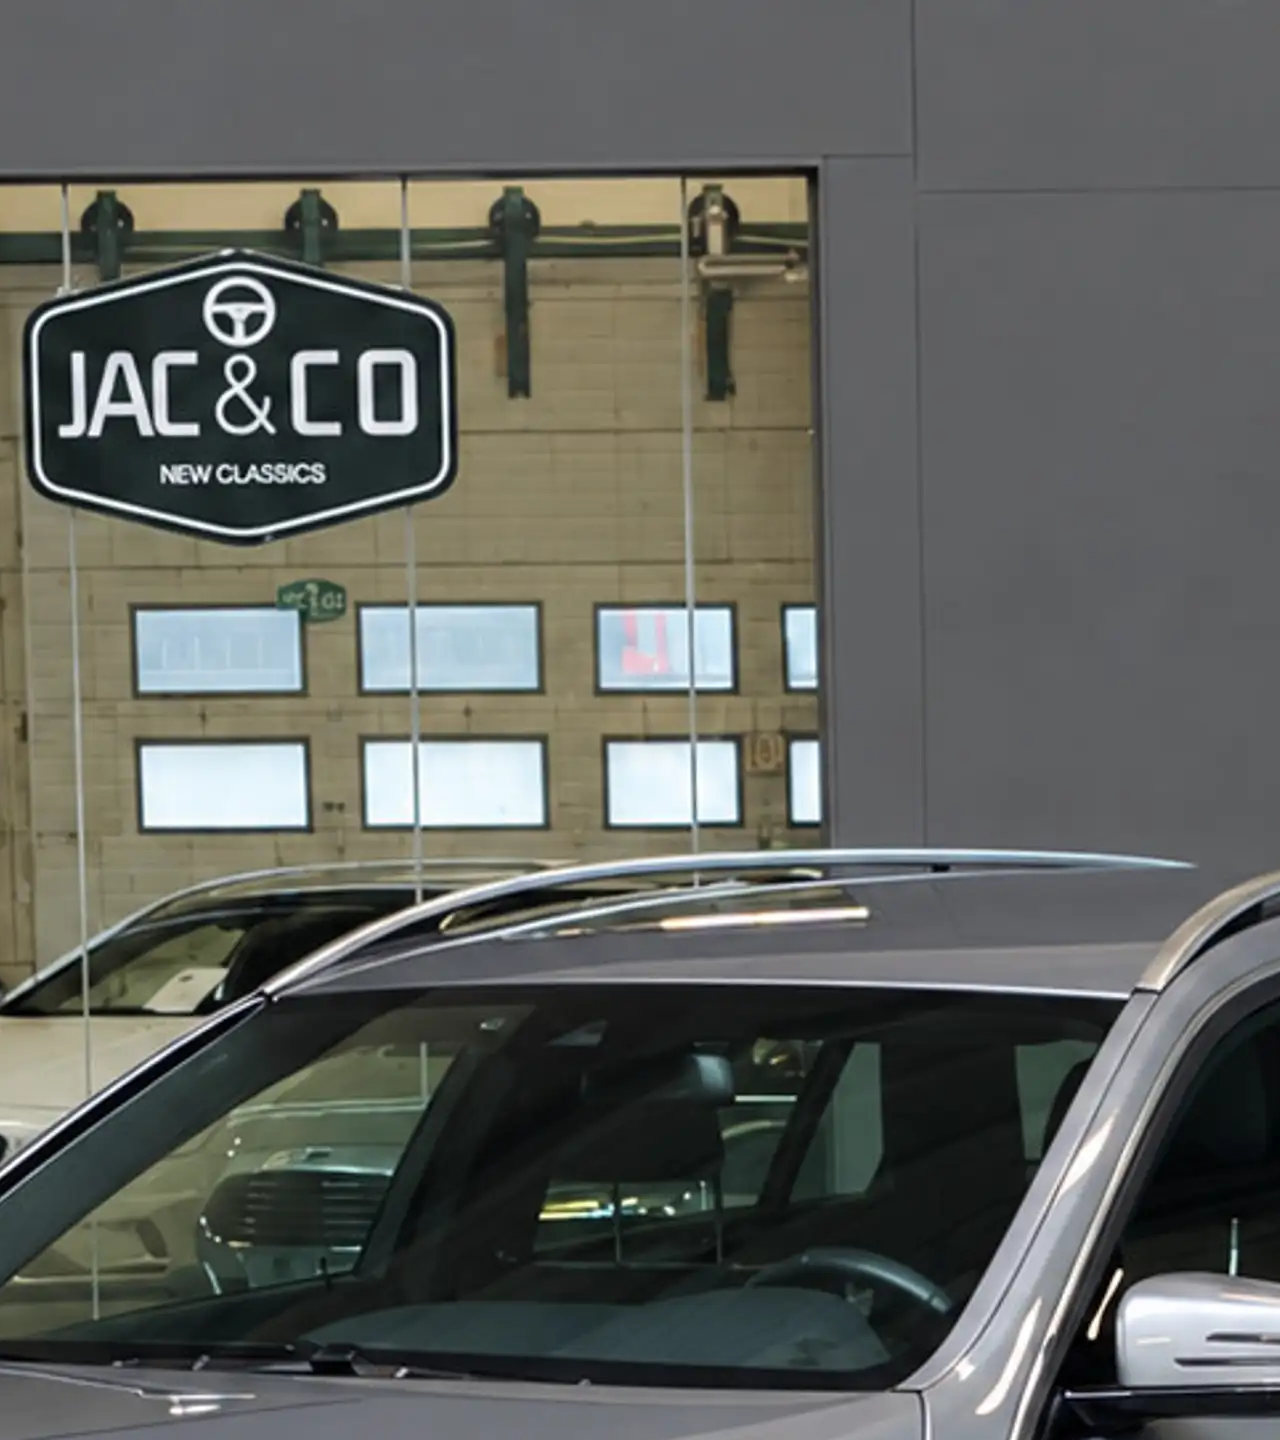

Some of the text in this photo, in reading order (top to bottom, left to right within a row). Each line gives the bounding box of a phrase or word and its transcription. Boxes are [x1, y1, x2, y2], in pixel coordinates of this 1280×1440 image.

[58, 350, 201, 438] JAC
[290, 349, 419, 436] CO
[160, 463, 326, 484] NEW CLASSICS
